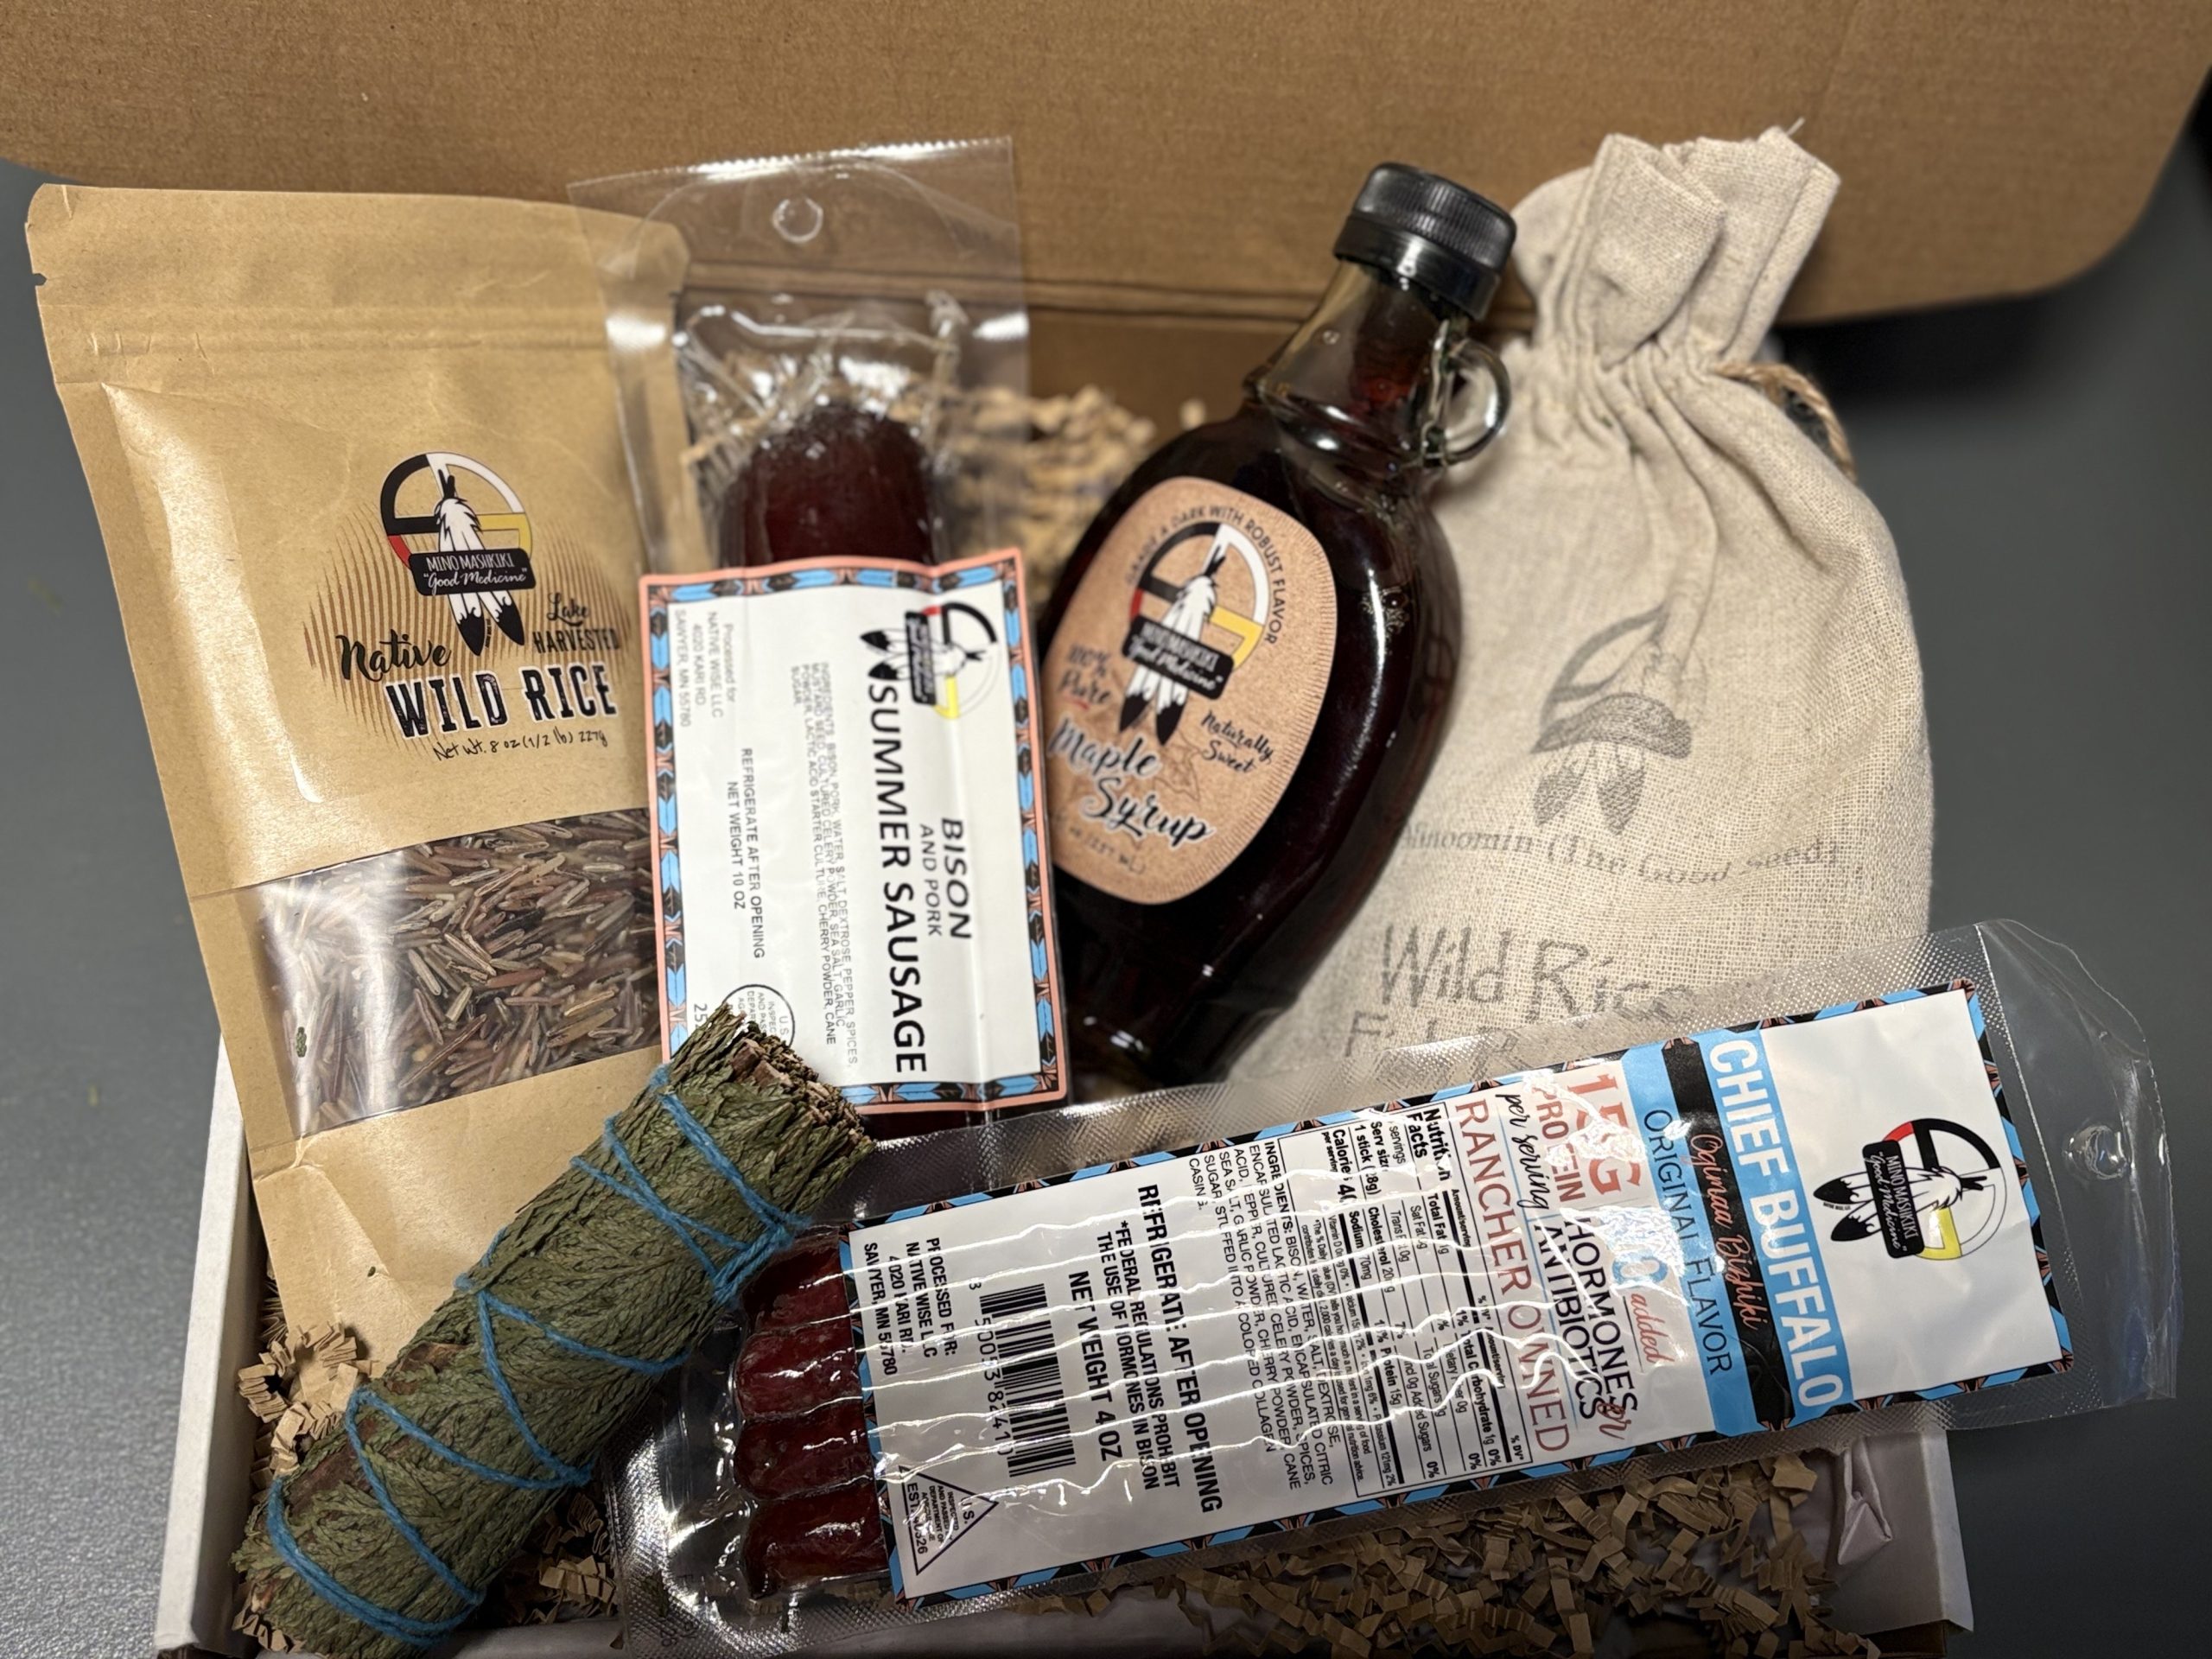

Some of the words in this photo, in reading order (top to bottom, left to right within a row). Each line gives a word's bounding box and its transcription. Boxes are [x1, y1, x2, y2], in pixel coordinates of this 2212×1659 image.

[427, 555, 459, 572] MINO
[1210, 506, 1244, 525] WITH
[1245, 519, 1283, 574] ROBUST
[1265, 579, 1286, 645] FLAVOR
[546, 592, 589, 627] Lake
[532, 626, 620, 654] HARVESTED
[690, 623, 704, 652] 4020
[704, 611, 720, 655] NATIVE
[720, 623, 738, 683] Processed
[335, 628, 451, 683] Native
[692, 655, 706, 683] KARI
[708, 658, 721, 691] WISE
[677, 669, 690, 688] MN
[726, 687, 737, 702] for
[1060, 671, 1111, 704] Pure
[385, 672, 508, 739] WILD
[520, 663, 617, 722] RICE
[677, 691, 692, 727] 55780
[709, 694, 723, 718] LLC
[433, 739, 461, 761] Net
[491, 739, 498, 753] 8
[504, 738, 520, 749] oz
[1048, 717, 1160, 778] Maple
[1201, 709, 1274, 765] Naturally
[1202, 740, 1257, 773] Sweet
[726, 781, 740, 807] NET
[738, 747, 760, 842] REFRIGERATE
[807, 760, 818, 786] ACID
[869, 684, 911, 868] SUMMER
[809, 790, 823, 842] STARTER
[1082, 777, 1211, 848] Syrup
[727, 813, 744, 866] WEIGHT
[821, 819, 835, 864] CELERY
[920, 824, 938, 872] AND
[731, 871, 743, 886] 10
[745, 846, 762, 891] AFTER
[942, 818, 972, 938] BISON
[733, 890, 746, 909] OZ
[925, 880, 942, 936] PORK
[748, 895, 766, 958] OPENING
[816, 904, 830, 952] CHERRY
[828, 924, 840, 946] SEA
[818, 955, 835, 1009] POWDER,
[883, 882, 927, 1072] SAUSAGE
[1382, 925, 1514, 1007] Wild
[831, 984, 845, 1027] GARLIC
[823, 1012, 836, 1044] CANE
[843, 1021, 859, 1067] SPICES,
[1355, 1134, 1372, 1163] stick
[1370, 1121, 1386, 1147] Serv
[1386, 1125, 1408, 1165] servings
[1405, 1111, 1431, 1159] Facts
[1496, 1092, 1524, 1128] per
[1511, 1133, 1550, 1210] serving
[1231, 1147, 1250, 1181] ACID,
[1884, 1154, 1905, 1185] MINO
[1389, 1210, 1405, 1234] Trans
[1409, 1205, 1422, 1220] Sat
[1414, 1221, 1426, 1237] Fat
[1427, 1193, 1443, 1221] Total
[1708, 1038, 1789, 1185] CHIEF
[1749, 1189, 1847, 1408] BUFFALO
[1891, 1185, 1918, 1239] MASHKIKI
[1096, 1231, 1116, 1263] THE
[1347, 1210, 1367, 1249] Sodium
[1433, 1222, 1447, 1240] Fat
[1681, 1132, 1732, 1236] Ogimaa
[1715, 1232, 1769, 1332] Bizhiki
[905, 1242, 927, 1291] NATIVE
[924, 1237, 953, 1318] PROCESSED
[1139, 1185, 1185, 1330] REFRIGERATE
[1396, 1249, 1411, 1262] 0g
[1455, 1098, 1533, 1295] RANCHER
[1507, 1305, 1573, 1453] OWNED
[1067, 1270, 1096, 1314] NET
[1103, 1265, 1122, 1296] USE
[874, 1306, 891, 1329] MN
[892, 1293, 911, 1325] KARI
[913, 1294, 933, 1327] WISE
[1109, 1300, 1127, 1320] OF
[1217, 1151, 1233, 1176] SEA
[1256, 1328, 1279, 1383] CHERRY
[1282, 1452, 1300, 1490] CANE
[1536, 1221, 1593, 1420] ANTIBIOTICS
[1565, 1217, 1637, 1414] HORMONES
[1630, 1291, 1672, 1364] added
[1683, 1257, 1734, 1376] FLAVOR
[1075, 1317, 1114, 1405] WEIGHT
[1168, 1335, 1201, 1407] AFTER
[1127, 1300, 1166, 1409] REGULATIONS
[1149, 1413, 1181, 1490] PROHIBIT
[1386, 1388, 1402, 1406] 15g
[1425, 1370, 1445, 1404] Sugars
[1093, 1408, 1116, 1425] 4
[1131, 1417, 1149, 1435] IN
[1405, 1376, 1420, 1389] 0g
[1414, 1421, 1434, 1452] Sugars
[1425, 1460, 1440, 1478] 0%
[1454, 1401, 1467, 1414] 0g
[1466, 1452, 1481, 1470] 0%
[1595, 1398, 1633, 1441] or
[1096, 1429, 1124, 1461] OZ
[1135, 1438, 1160, 1490] BISON
[1184, 1413, 1224, 1513] OPENING
[1313, 1441, 1333, 1485] CITRIC
[1487, 1448, 1500, 1466] 0%
[927, 1485, 943, 1532] DEPARTMENT
[937, 1485, 945, 1500] AND
